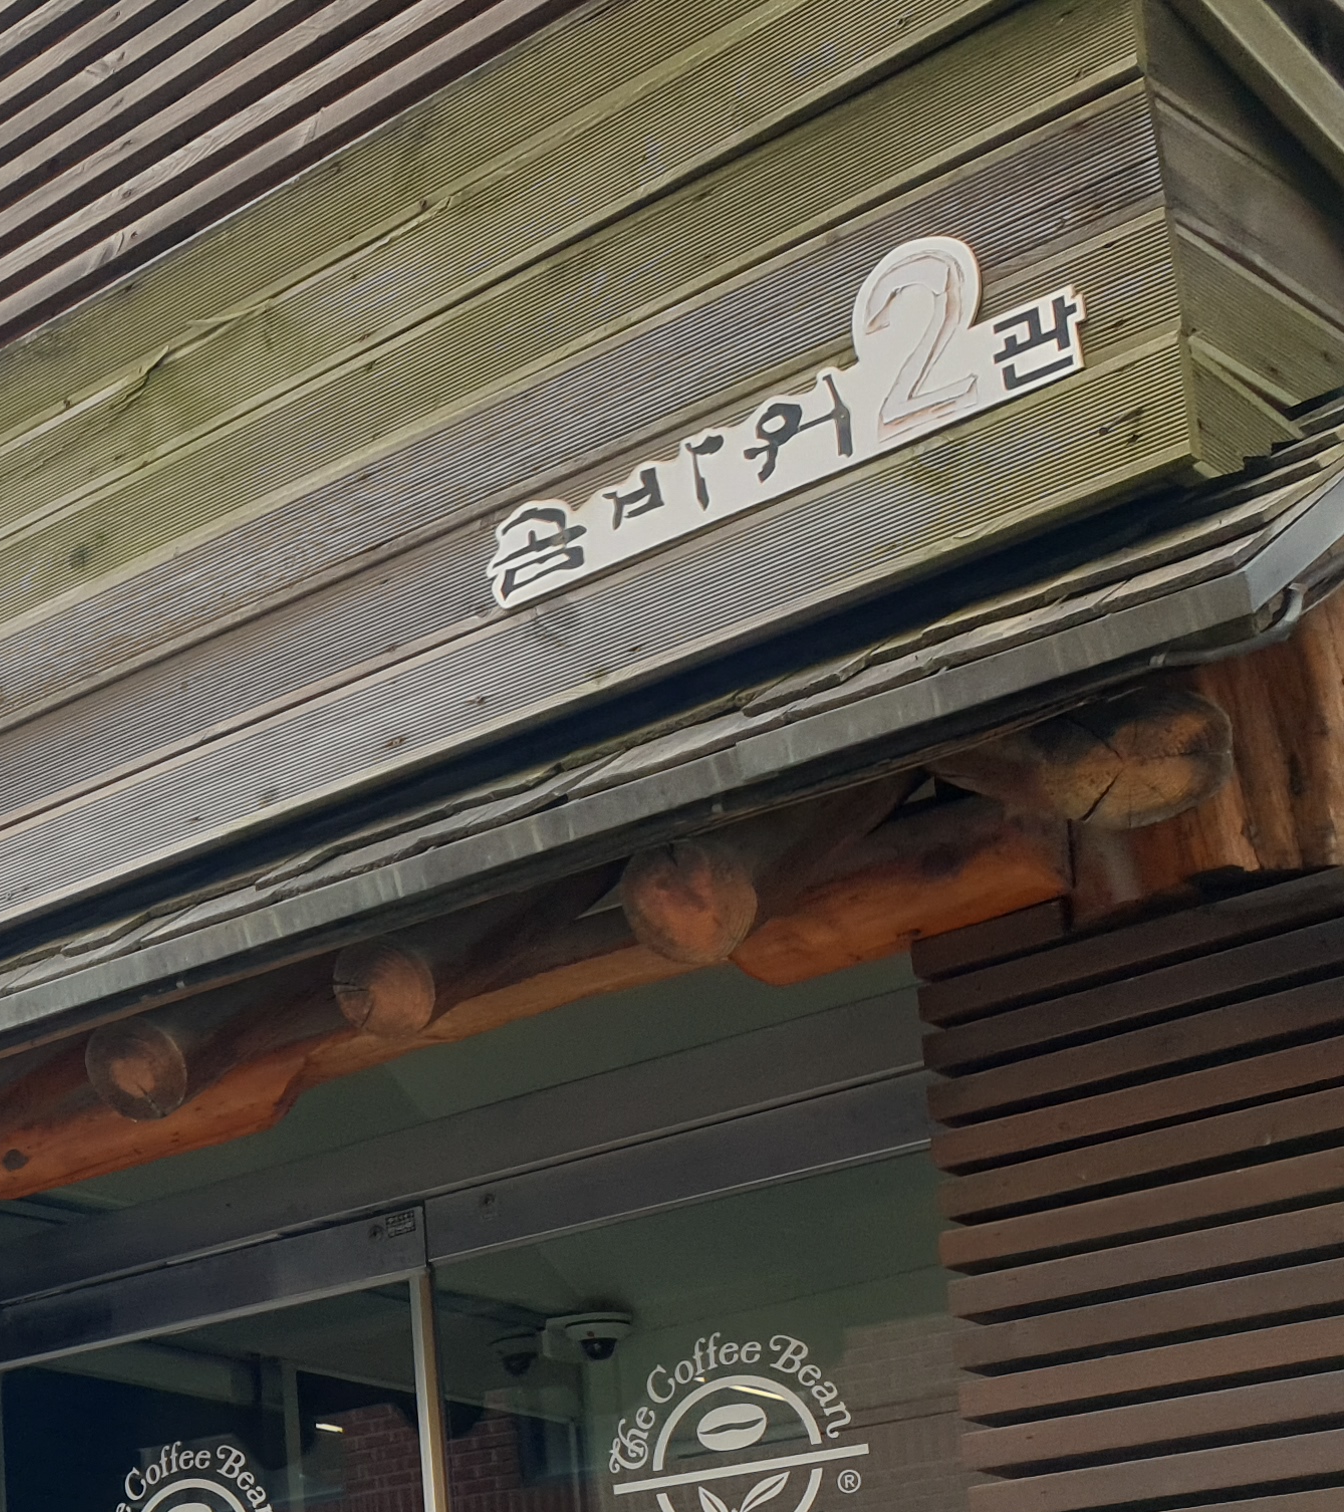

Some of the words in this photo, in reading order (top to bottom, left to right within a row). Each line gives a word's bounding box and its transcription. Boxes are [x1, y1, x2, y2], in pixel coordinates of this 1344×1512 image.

[492, 373, 854, 600] 곰바위
[125, 1441, 211, 1502] Coffee
[609, 1406, 656, 1474] The
[646, 1332, 762, 1404] Coffee
[769, 1334, 852, 1439] Bean
